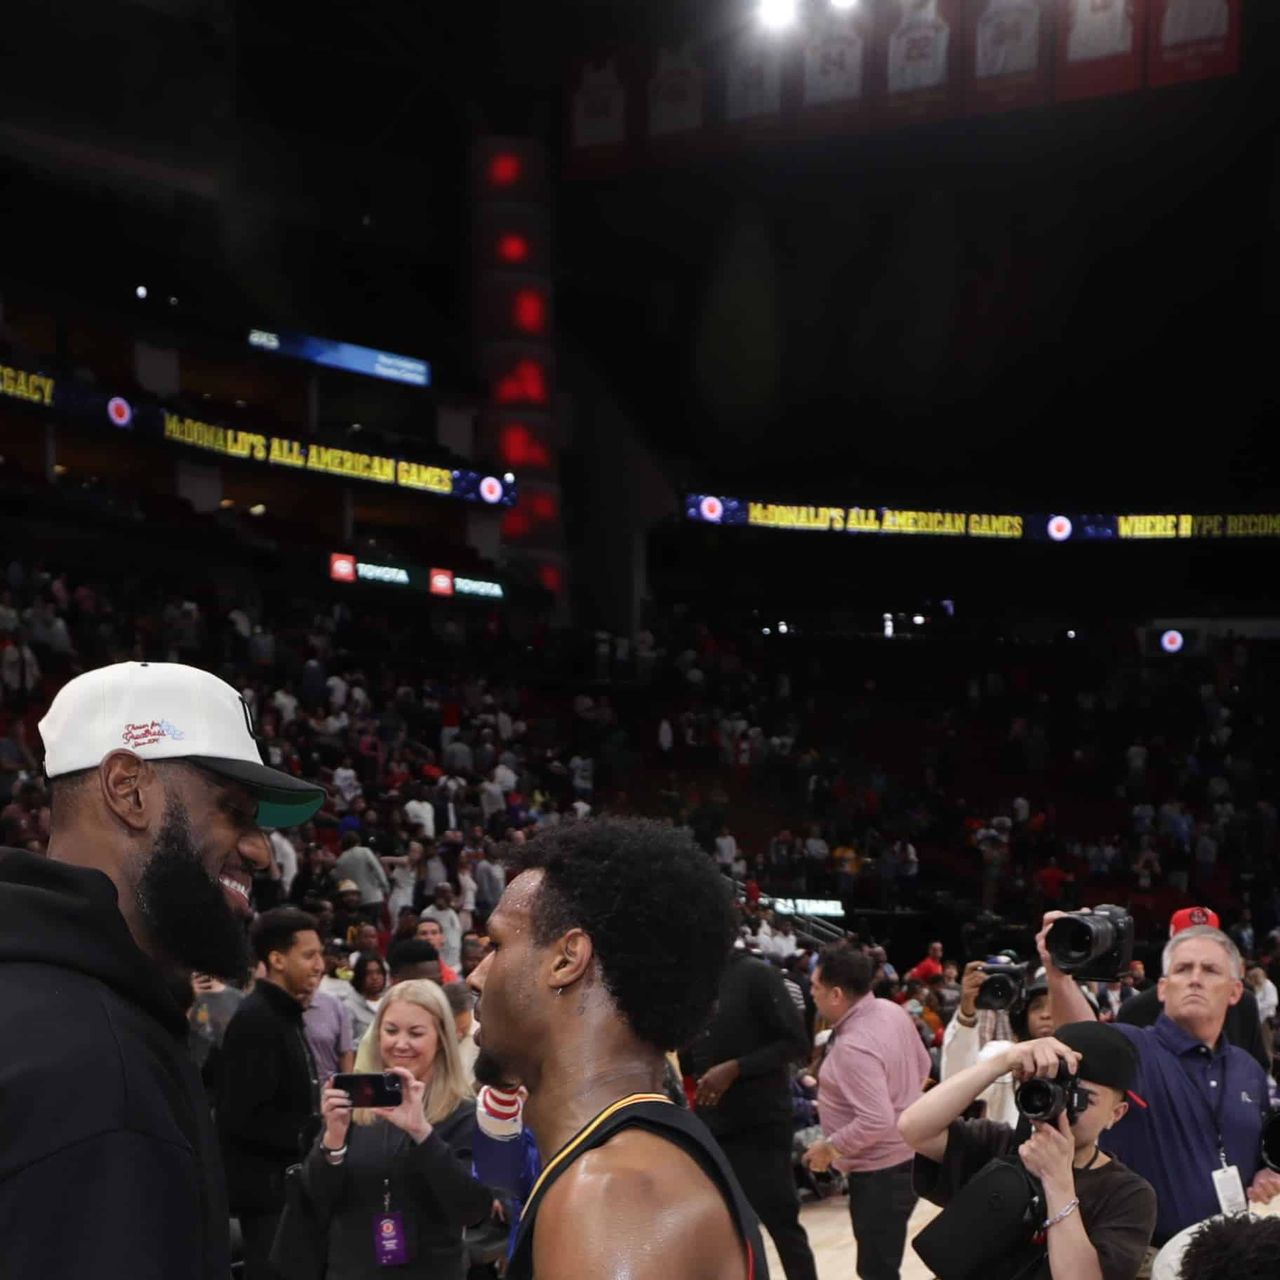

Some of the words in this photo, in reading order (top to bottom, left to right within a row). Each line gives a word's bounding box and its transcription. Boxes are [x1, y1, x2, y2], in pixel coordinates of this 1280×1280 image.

[163, 411, 267, 463] McDONALD'S
[269, 436, 306, 468] ALL
[306, 443, 396, 485] AMERICAN
[397, 460, 453, 495] GAMES
[748, 502, 845, 532] McDONALD'S
[846, 507, 880, 534] ALL
[881, 508, 966, 536] AMERICAN
[968, 513, 1024, 539] GAMES
[1118, 514, 1178, 539] WHERE
[1178, 514, 1220, 538] HYPE
[355, 562, 409, 585] TOYOTA
[453, 577, 505, 599] TOYOTA
